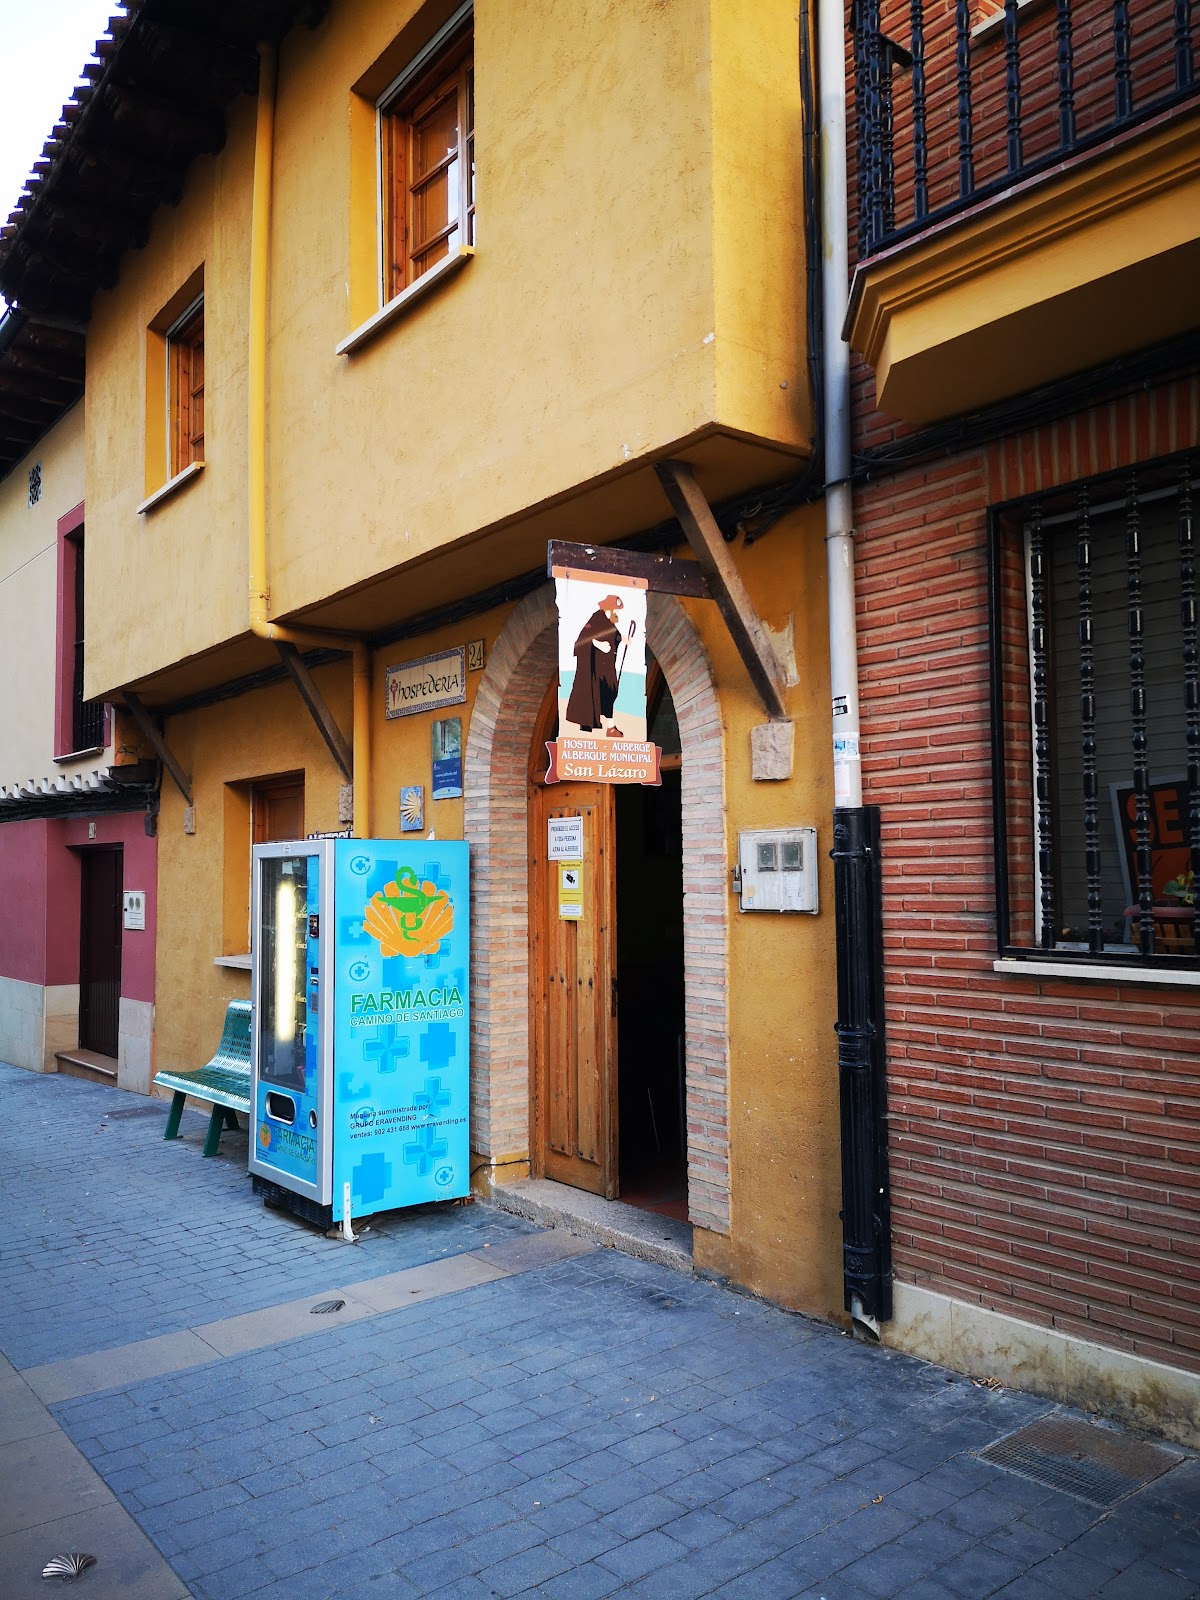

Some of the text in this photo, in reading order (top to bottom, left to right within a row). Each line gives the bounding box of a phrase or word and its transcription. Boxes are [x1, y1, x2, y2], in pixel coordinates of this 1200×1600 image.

[470, 643, 483, 667] 24
[563, 739, 599, 750] HOSTEL
[611, 742, 651, 753] AUBERGE
[561, 750, 653, 763] ALBERGUE MUNICIPAL
[564, 762, 647, 779] San Lázaro
[351, 987, 462, 1014] FARMACIA
[350, 1008, 464, 1027] CAMINO DE SANTIAGO
[350, 1114, 417, 1130] GRUPO ERAVENDING
[274, 1126, 315, 1153] FARMACIA
[350, 1130, 373, 1139] ventas:
